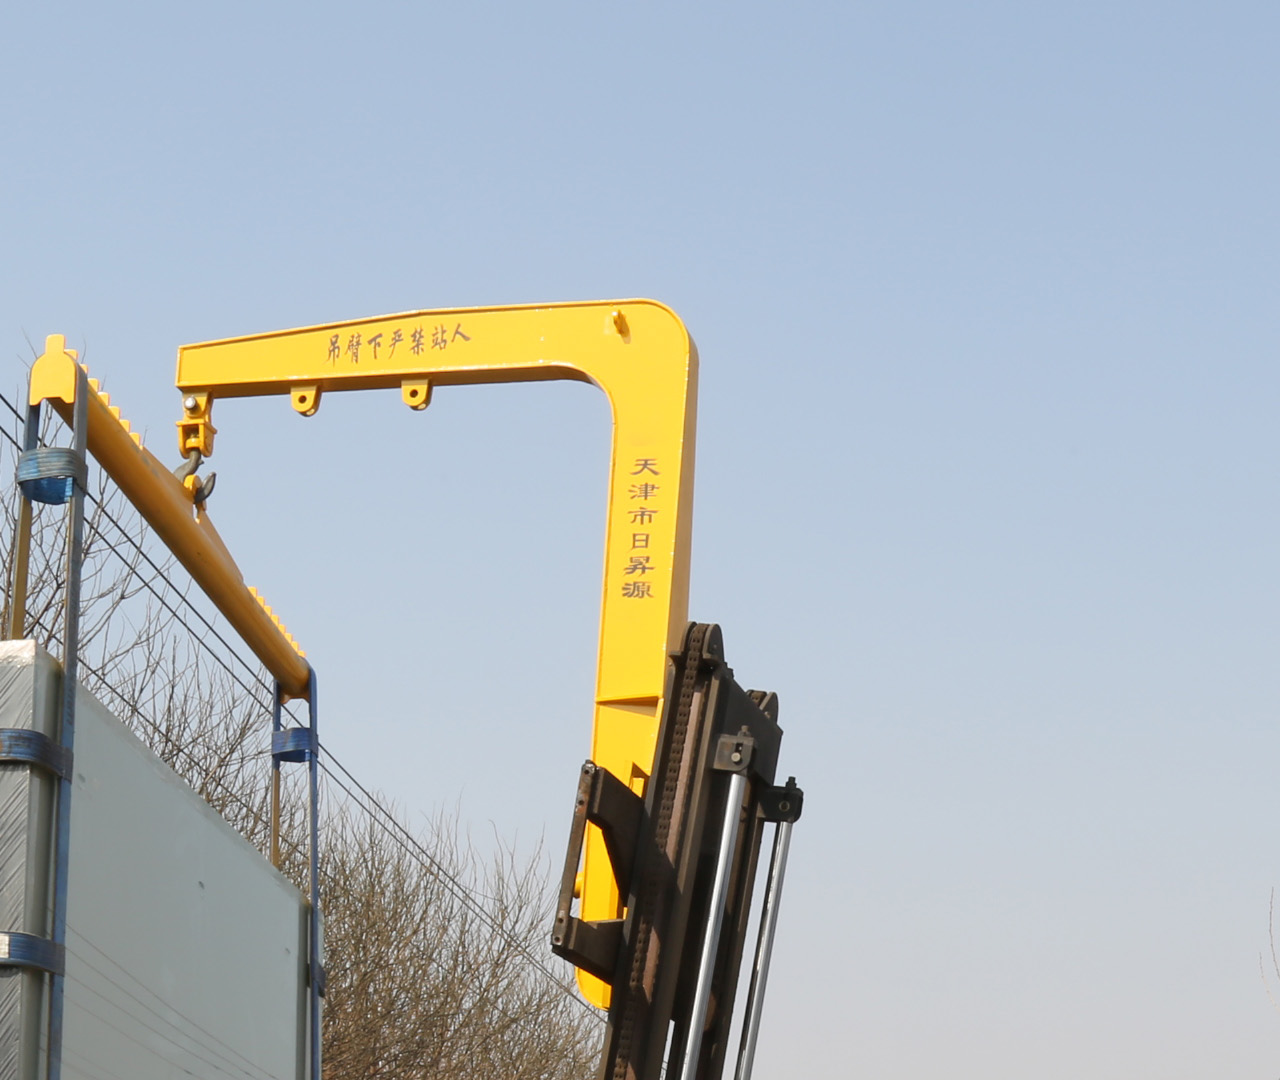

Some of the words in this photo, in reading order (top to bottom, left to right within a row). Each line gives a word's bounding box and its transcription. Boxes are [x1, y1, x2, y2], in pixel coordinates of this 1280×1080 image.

[326, 323, 471, 367] 吊臂下严禁站人
